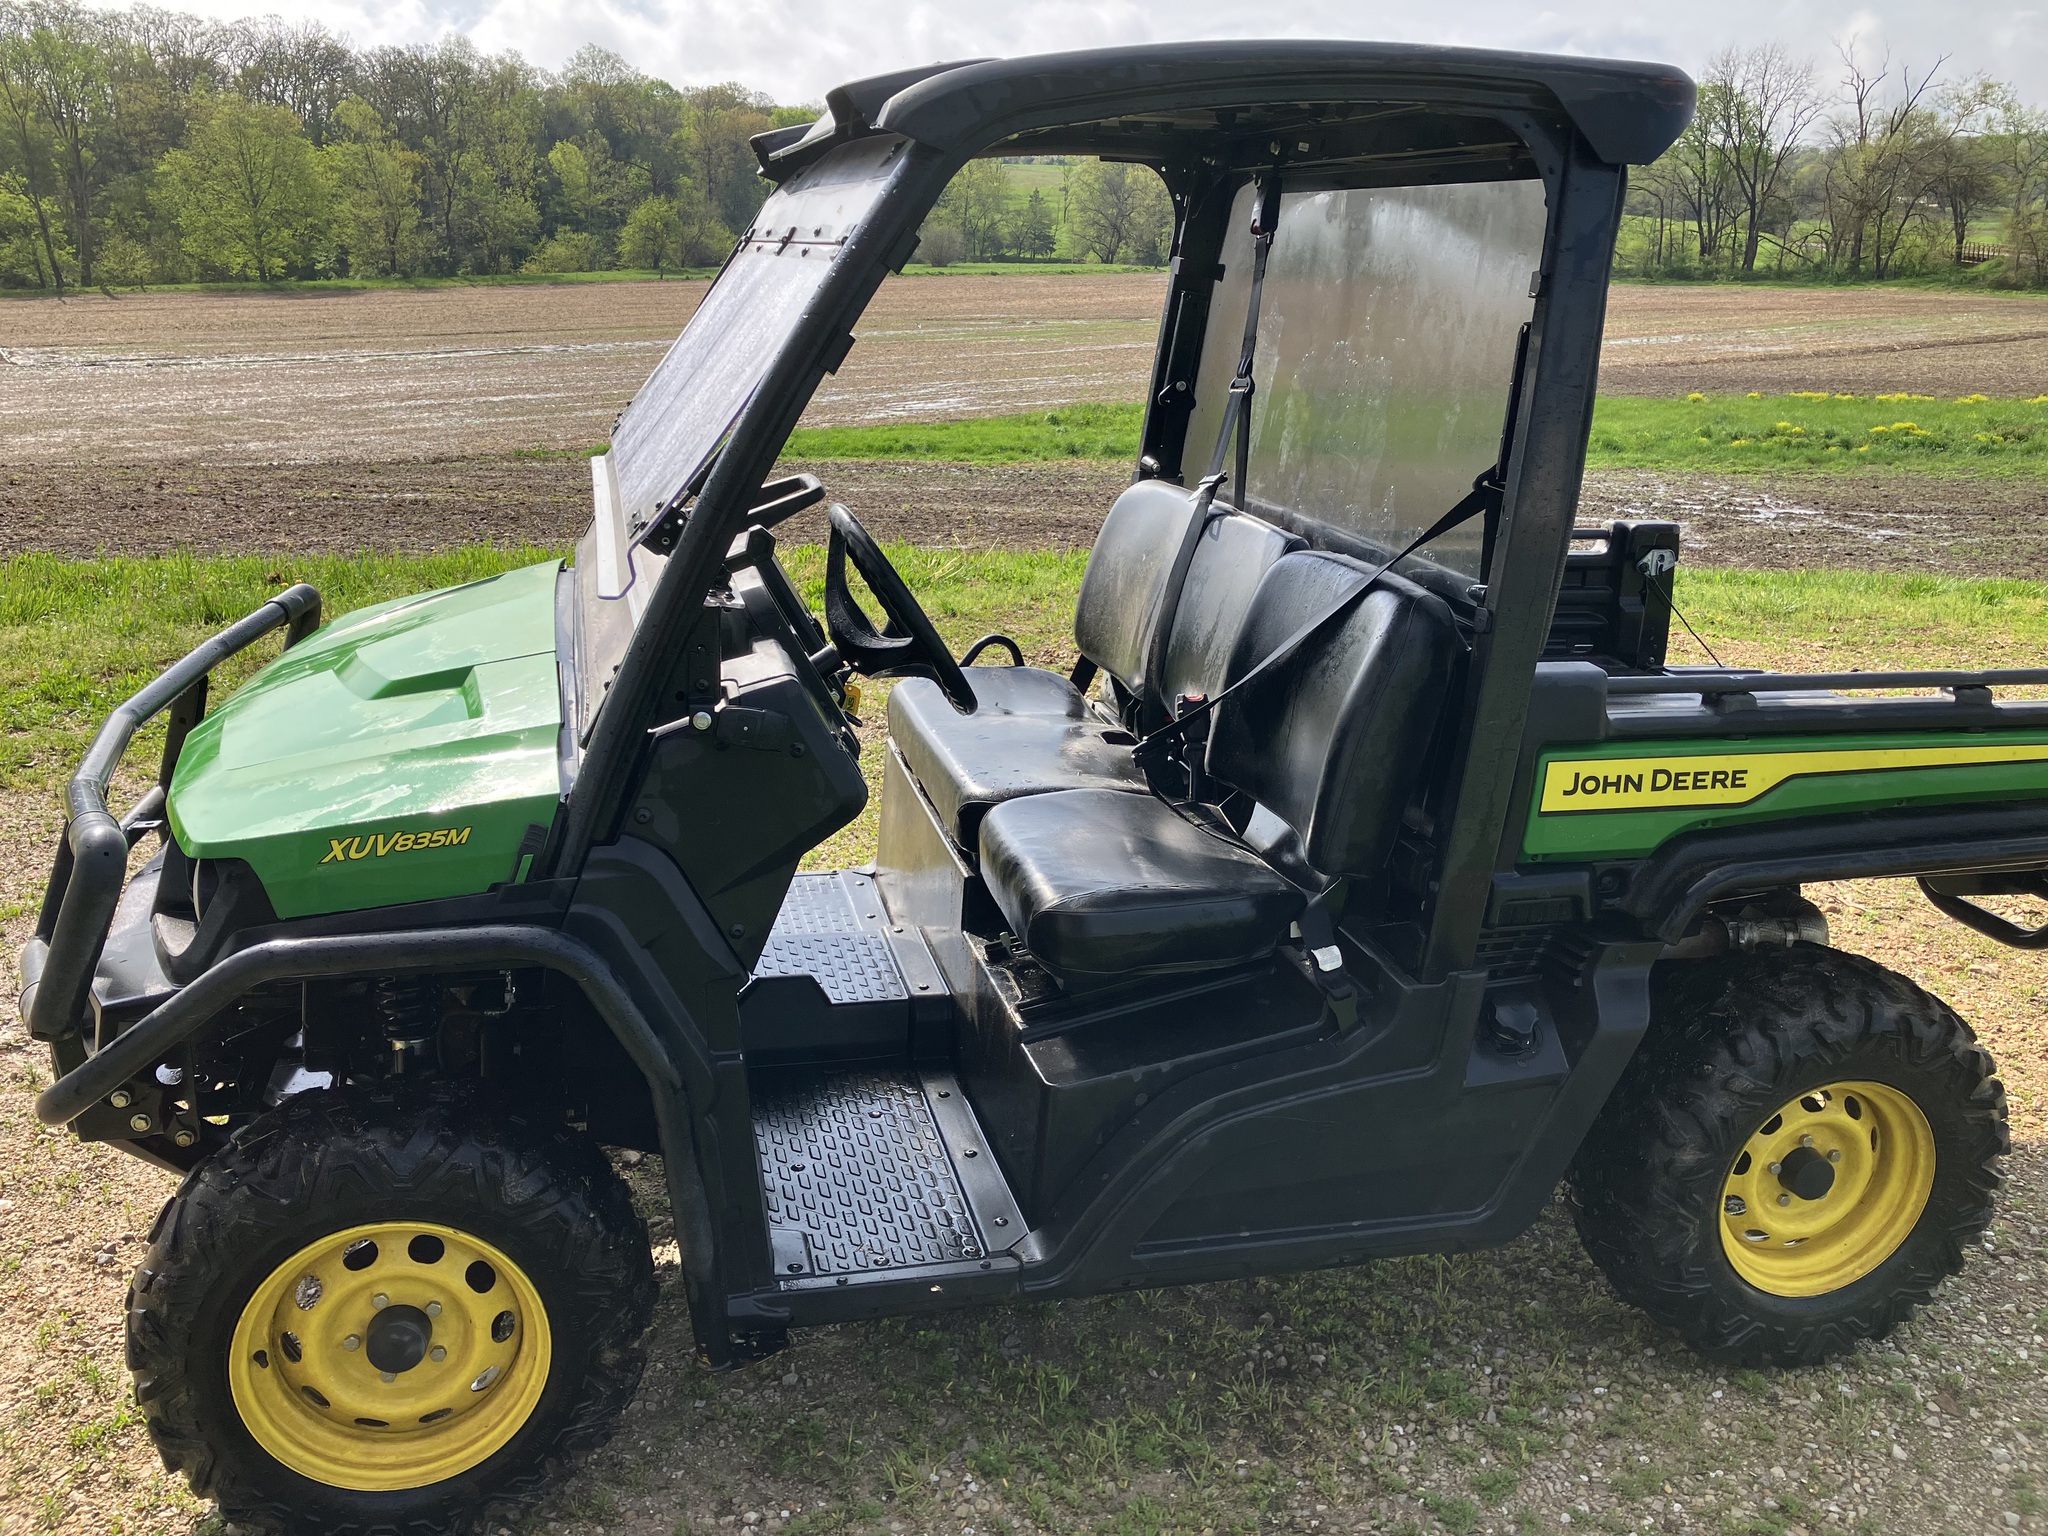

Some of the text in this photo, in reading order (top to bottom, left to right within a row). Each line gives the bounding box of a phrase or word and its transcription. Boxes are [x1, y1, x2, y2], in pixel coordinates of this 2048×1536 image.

[1562, 769, 1748, 796] JOHN DEERE
[317, 826, 472, 864] XUV835M
